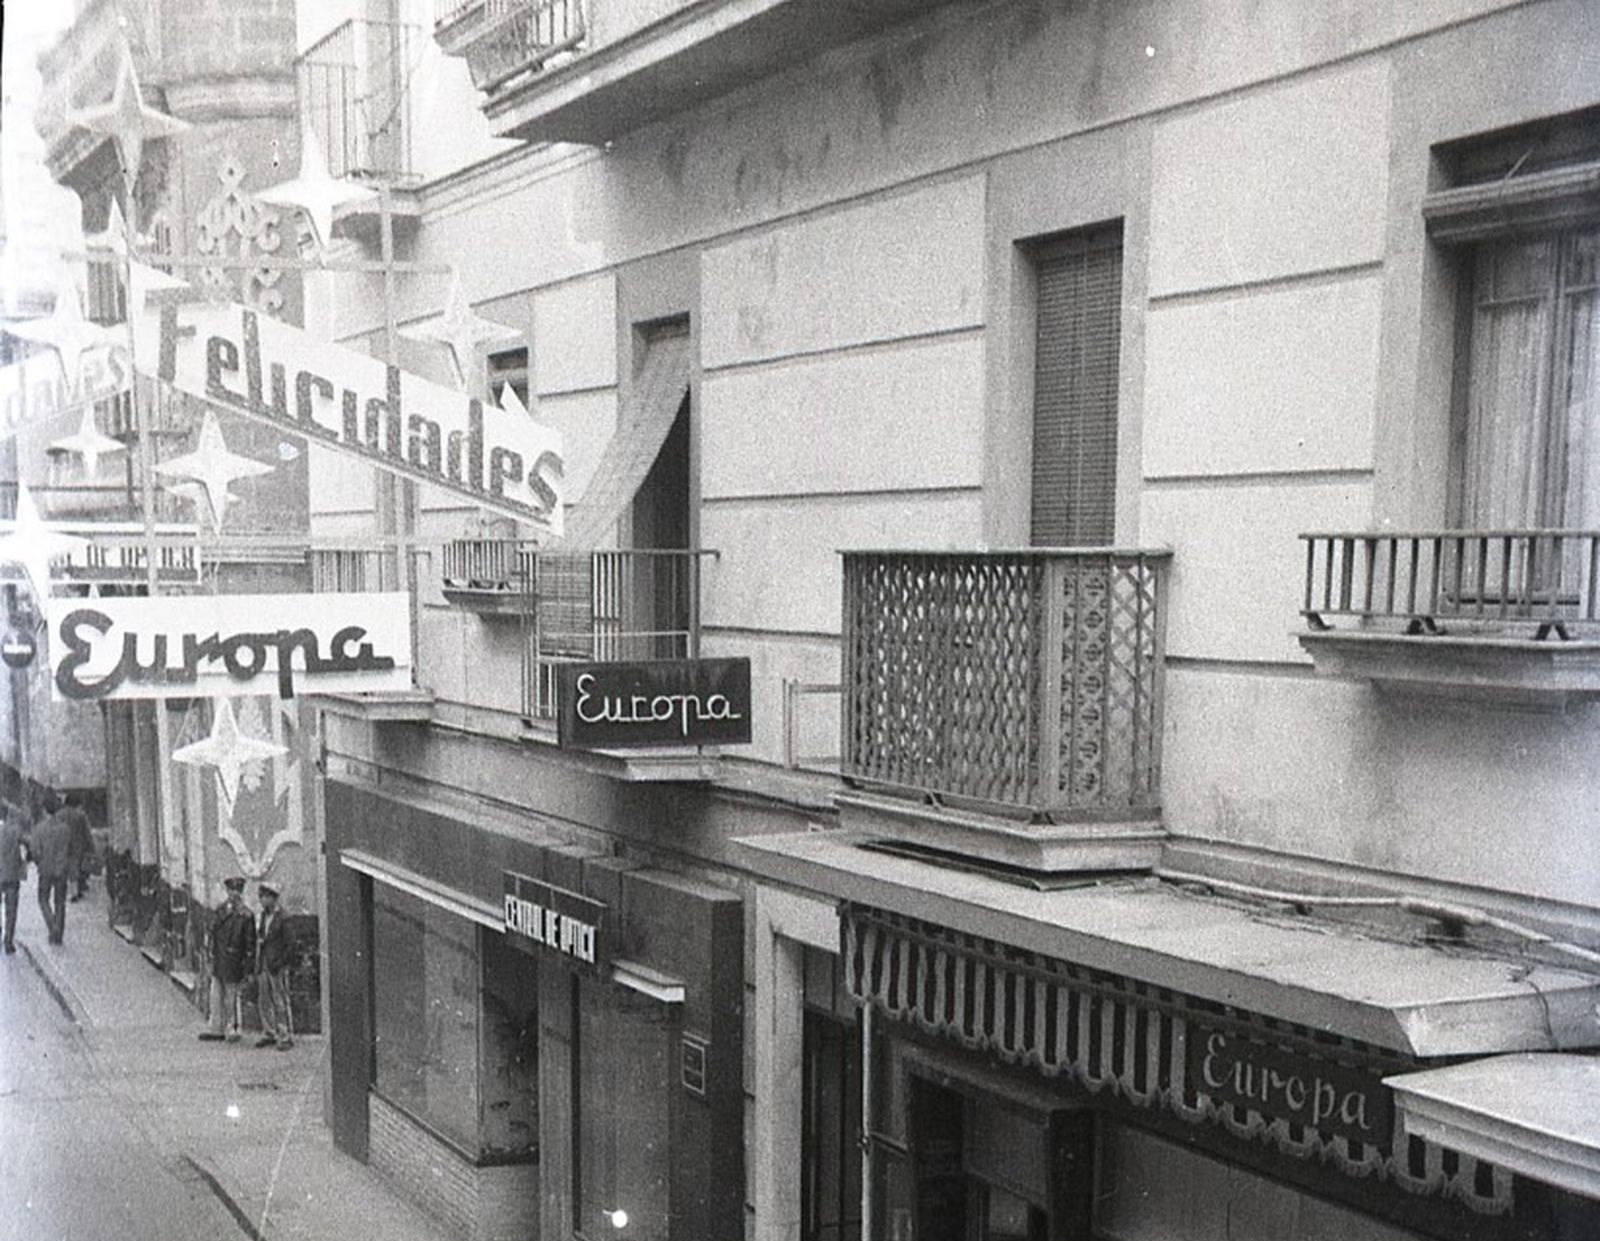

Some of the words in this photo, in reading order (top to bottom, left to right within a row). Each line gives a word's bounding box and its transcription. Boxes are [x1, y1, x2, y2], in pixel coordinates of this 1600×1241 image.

[158, 300, 563, 516] Felicidades
[55, 608, 394, 699] Europa
[577, 674, 741, 736] Europa
[1203, 1034, 1371, 1130] Europa
